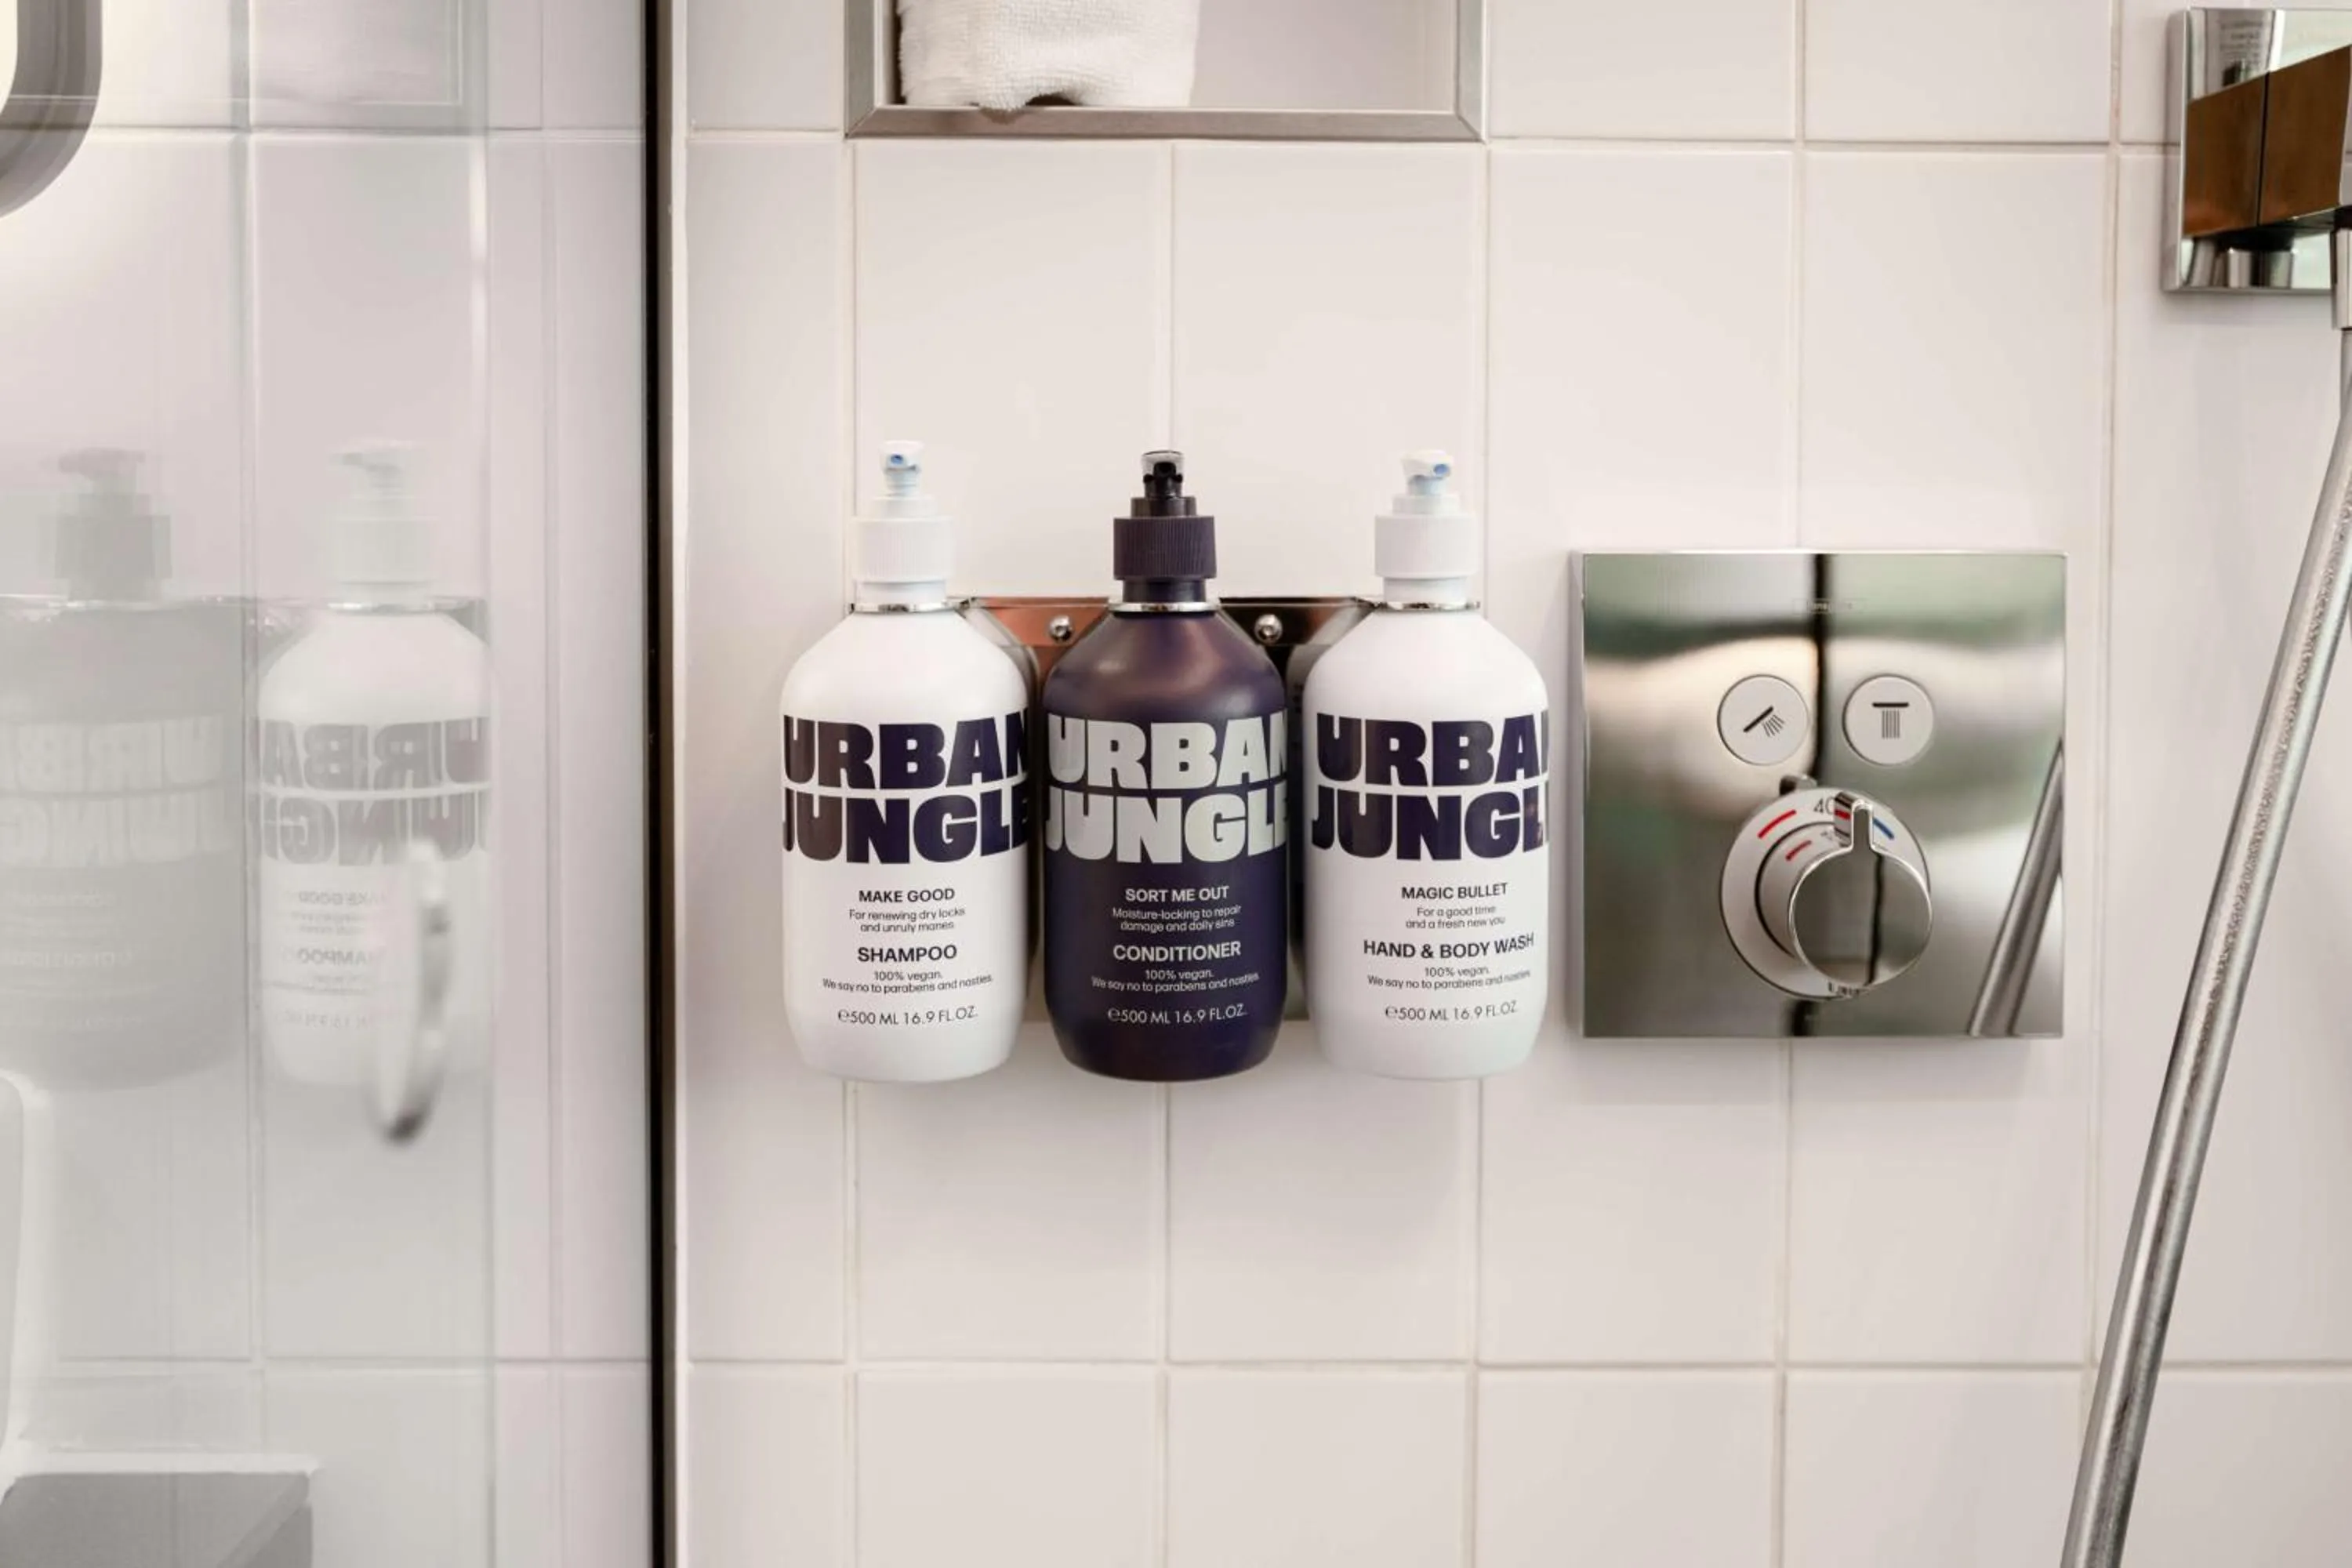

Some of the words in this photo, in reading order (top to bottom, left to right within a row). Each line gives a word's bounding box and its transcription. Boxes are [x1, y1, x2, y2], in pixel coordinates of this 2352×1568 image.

[1312, 780, 1548, 861] JUNGL
[858, 890, 903, 902] MAKE
[907, 888, 955, 902] GOOD
[1125, 887, 1169, 902] SORT
[1171, 888, 1195, 902] ME
[1199, 885, 1230, 901] OUT
[1401, 886, 1454, 899] MAGIC
[1457, 882, 1508, 899] BULLET
[849, 909, 865, 920] For
[868, 909, 916, 922] renewing
[919, 909, 936, 920] dry
[938, 906, 966, 918] locks
[1112, 906, 1200, 921] Moisture-locking
[1202, 908, 1213, 919] to
[1214, 905, 1242, 918] repair
[1417, 906, 1434, 916] For
[1446, 906, 1473, 919] good
[1475, 905, 1496, 915] time
[860, 922, 880, 932] and
[883, 923, 916, 933] unruly
[1120, 921, 1163, 934] damage
[1166, 921, 1187, 932] and
[1189, 920, 1213, 932] daily
[1406, 919, 1426, 929] and
[1437, 918, 1465, 929] fresh
[1467, 919, 1487, 927] new
[1112, 940, 1242, 963] CONDITIONER
[1363, 939, 1416, 958] HAND
[1421, 943, 1434, 959] &
[1440, 941, 1490, 959] BODY
[1494, 931, 1535, 954] WASH
[858, 944, 957, 963] SHAMPOO
[874, 971, 904, 981] 100%
[1145, 969, 1176, 981] 100%
[1178, 968, 1214, 981] vegan.
[1425, 967, 1454, 978] 100%
[838, 982, 854, 993] say
[855, 984, 869, 993] no
[871, 984, 881, 993] to
[884, 982, 935, 995] parabens
[937, 979, 957, 990] and
[1108, 981, 1125, 992] say
[1127, 982, 1141, 992] no
[1142, 982, 1152, 993] to
[1155, 981, 1207, 995] parabens
[1208, 978, 1227, 989] and
[1367, 974, 1383, 986] We
[1385, 978, 1403, 989] say
[1406, 979, 1419, 989] no
[1421, 979, 1432, 989] to
[1434, 978, 1483, 991] parabens
[1486, 975, 1503, 985] and
[879, 1012, 898, 1025] ML
[904, 1011, 935, 1025] 16.9
[1150, 1011, 1171, 1025] ML
[1174, 1008, 1207, 1024] 16.9
[1429, 1008, 1449, 1021] ML
[1454, 1006, 1483, 1021] 16.9
